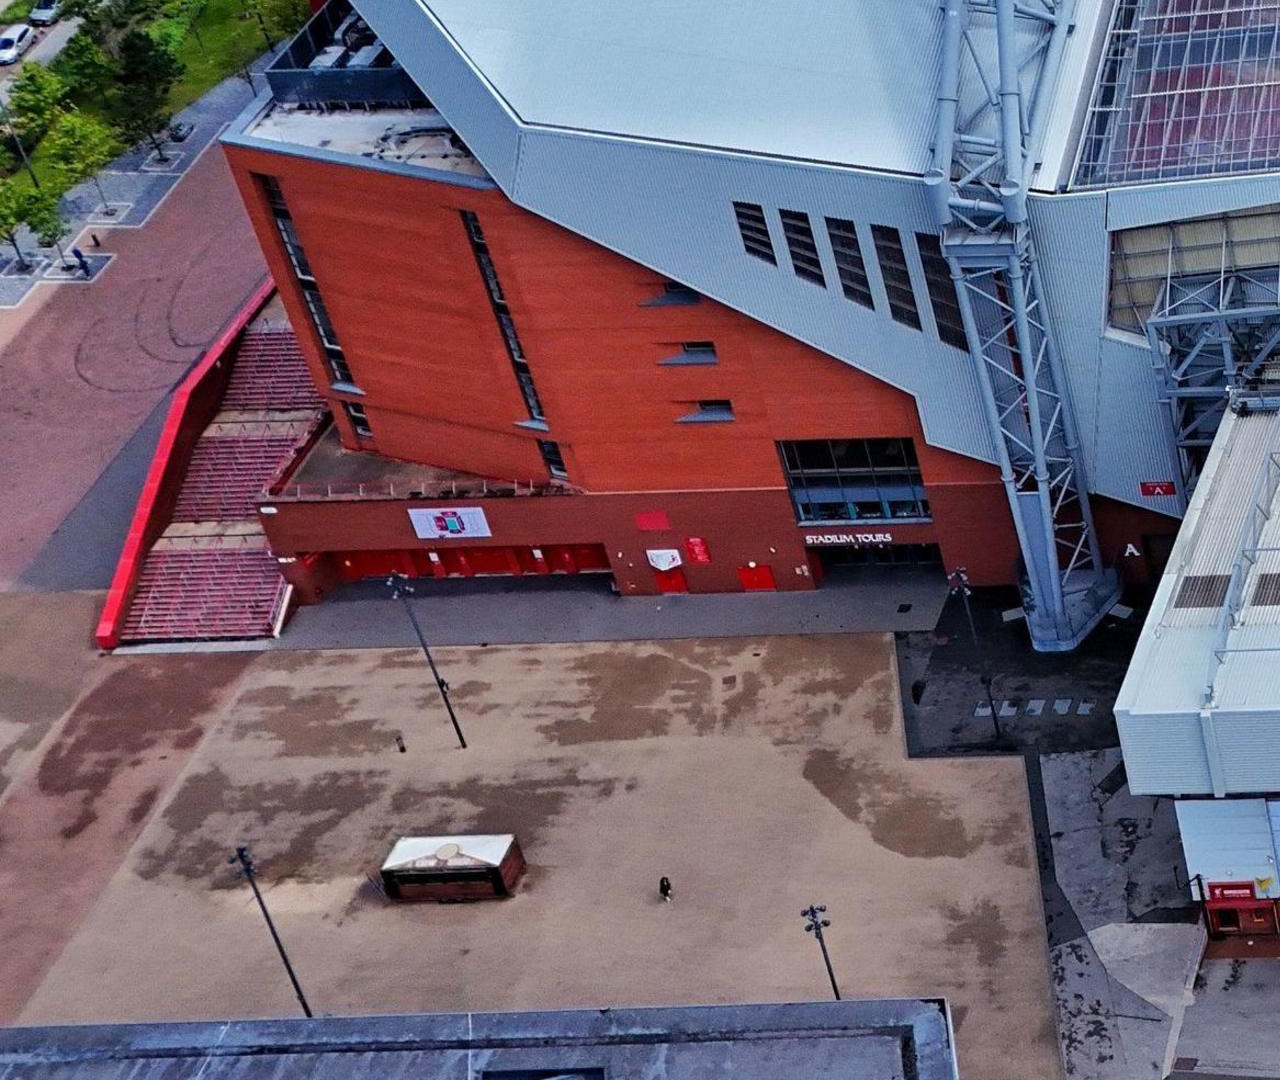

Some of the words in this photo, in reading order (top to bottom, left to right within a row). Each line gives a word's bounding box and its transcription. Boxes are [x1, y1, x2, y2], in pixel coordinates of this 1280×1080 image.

[805, 534, 855, 544] STADIUM
[856, 532, 892, 543] TOURS
[1124, 543, 1141, 557] A
